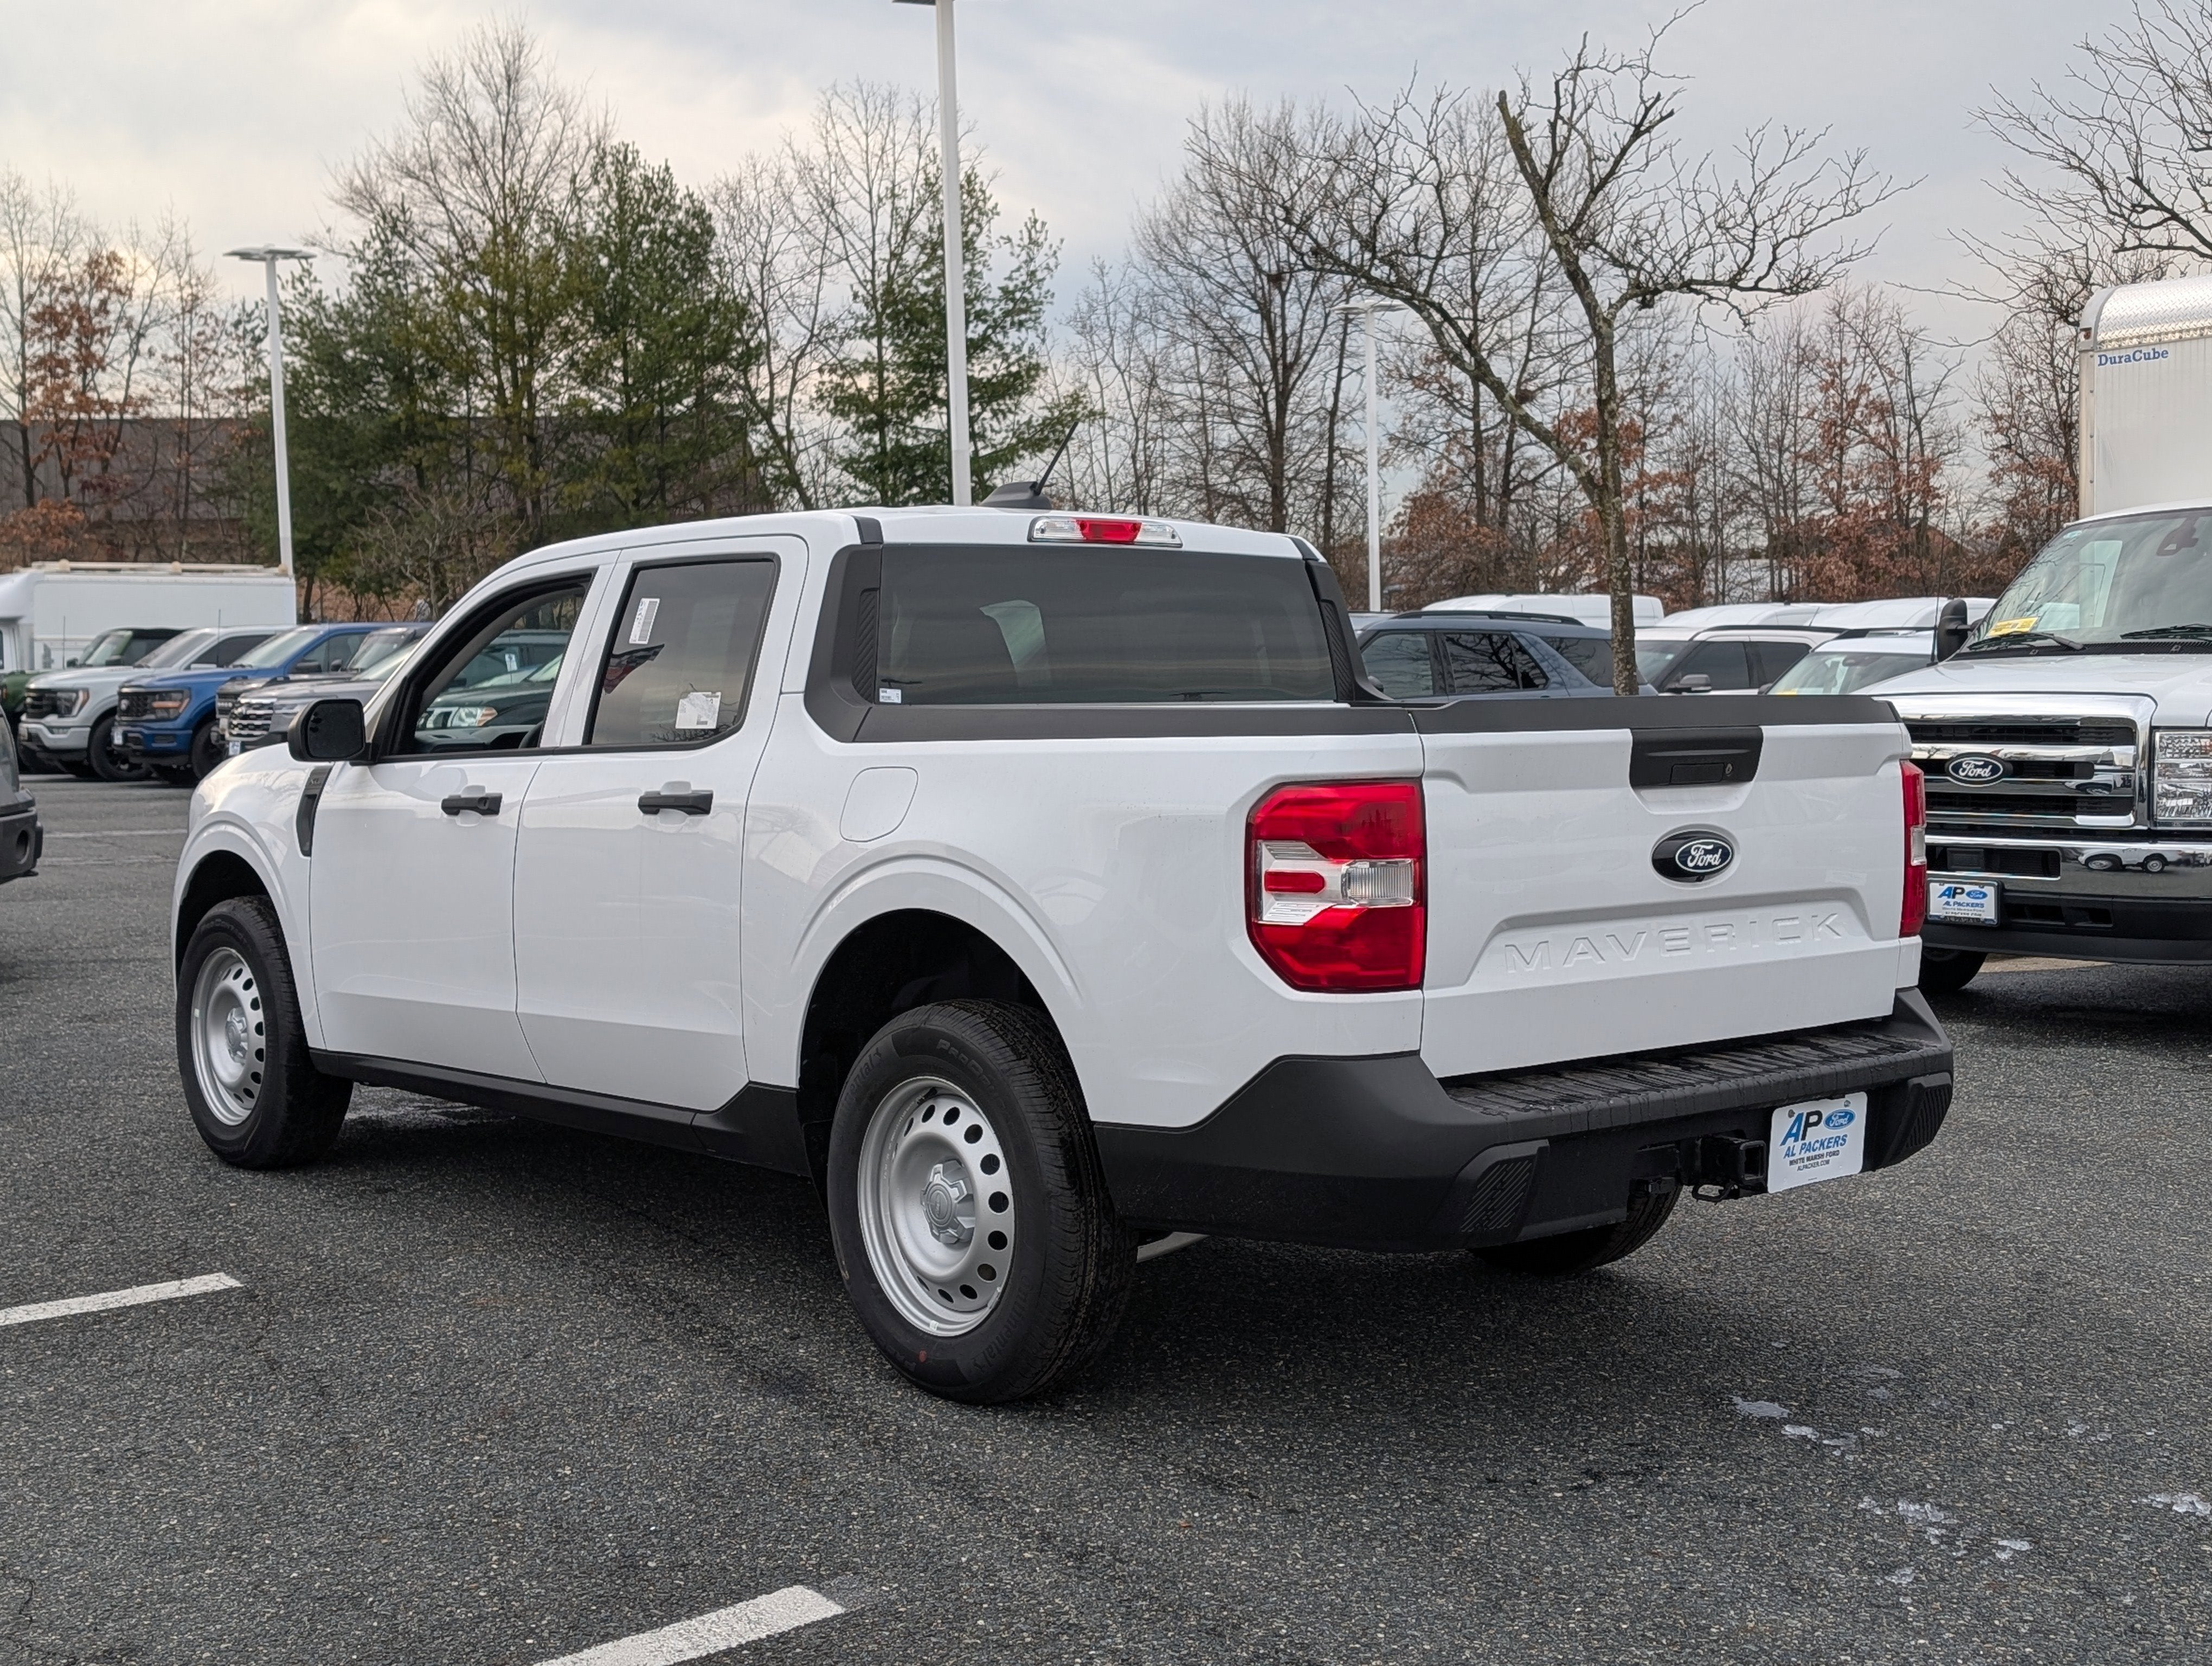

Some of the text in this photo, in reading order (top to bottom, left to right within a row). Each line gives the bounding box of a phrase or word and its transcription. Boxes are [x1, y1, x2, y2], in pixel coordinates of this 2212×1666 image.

[2098, 348, 2169, 367] DuraCube
[1958, 760, 1993, 777] Ford
[1687, 844, 1722, 867] Ford
[1938, 886, 1965, 899] AP
[1504, 912, 1842, 975] MAVERICK
[1780, 1110, 1850, 1146] AP Ford
[1783, 1134, 1848, 1159] AL PACKERS
[1825, 1150, 1840, 1158] FORD
